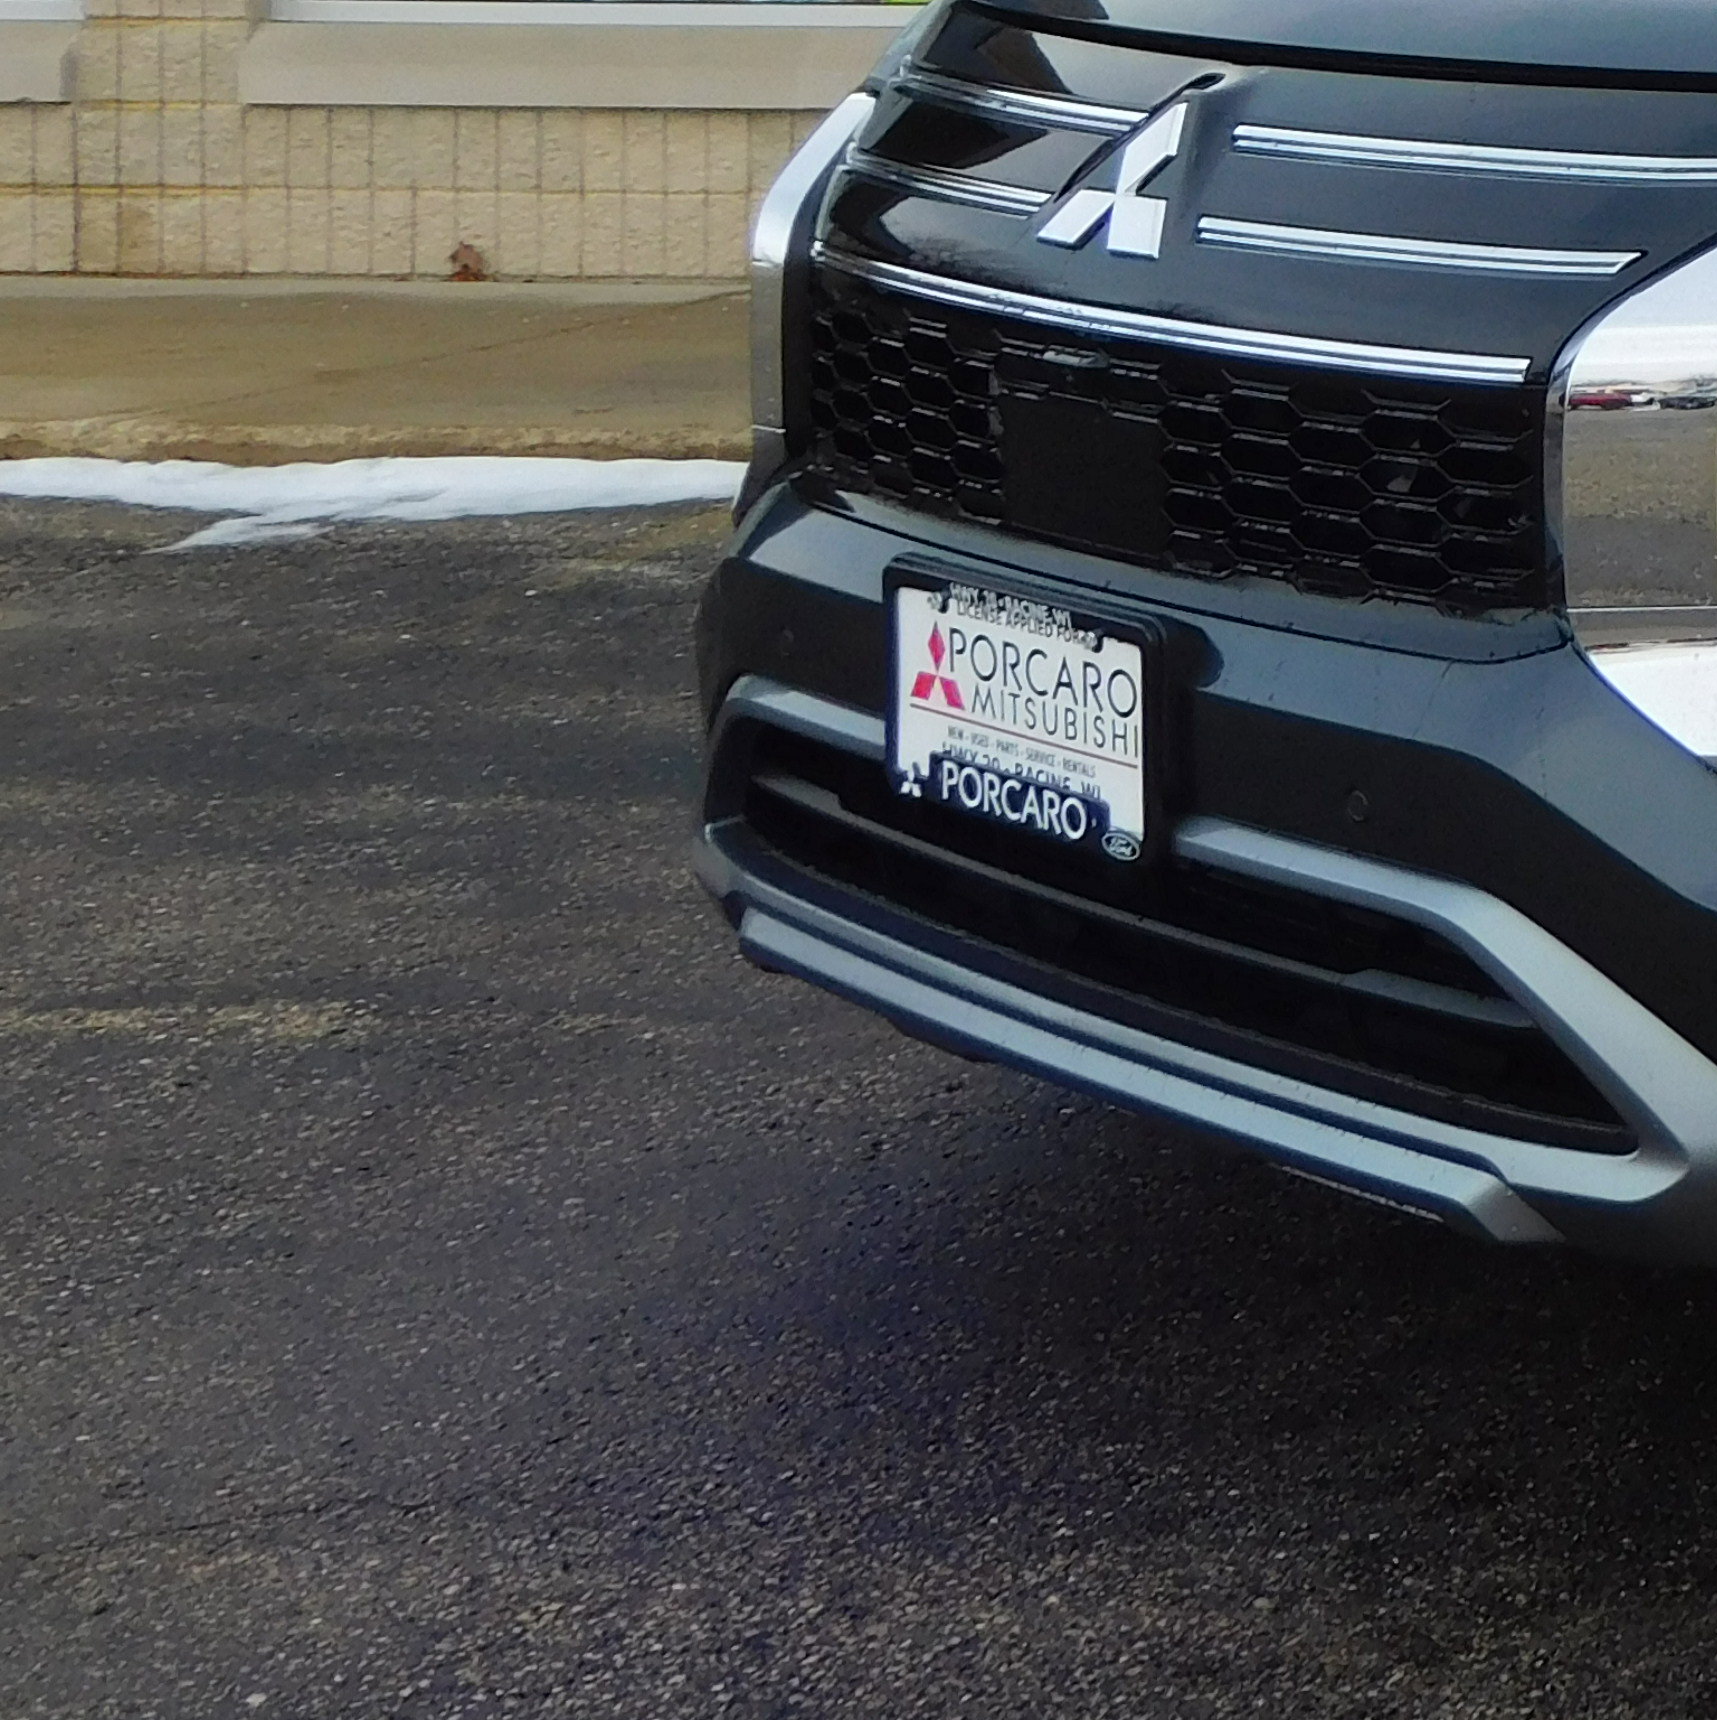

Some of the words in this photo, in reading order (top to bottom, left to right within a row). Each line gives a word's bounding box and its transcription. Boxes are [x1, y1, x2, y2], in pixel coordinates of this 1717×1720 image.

[949, 626, 1138, 719] PORCARO
[971, 682, 1139, 759] MITSUBISHI
[996, 739, 1020, 757] PARTS
[1025, 747, 1056, 768] SERVICE
[1062, 757, 1097, 779] RENTALS
[941, 759, 1088, 840] PORCARO
